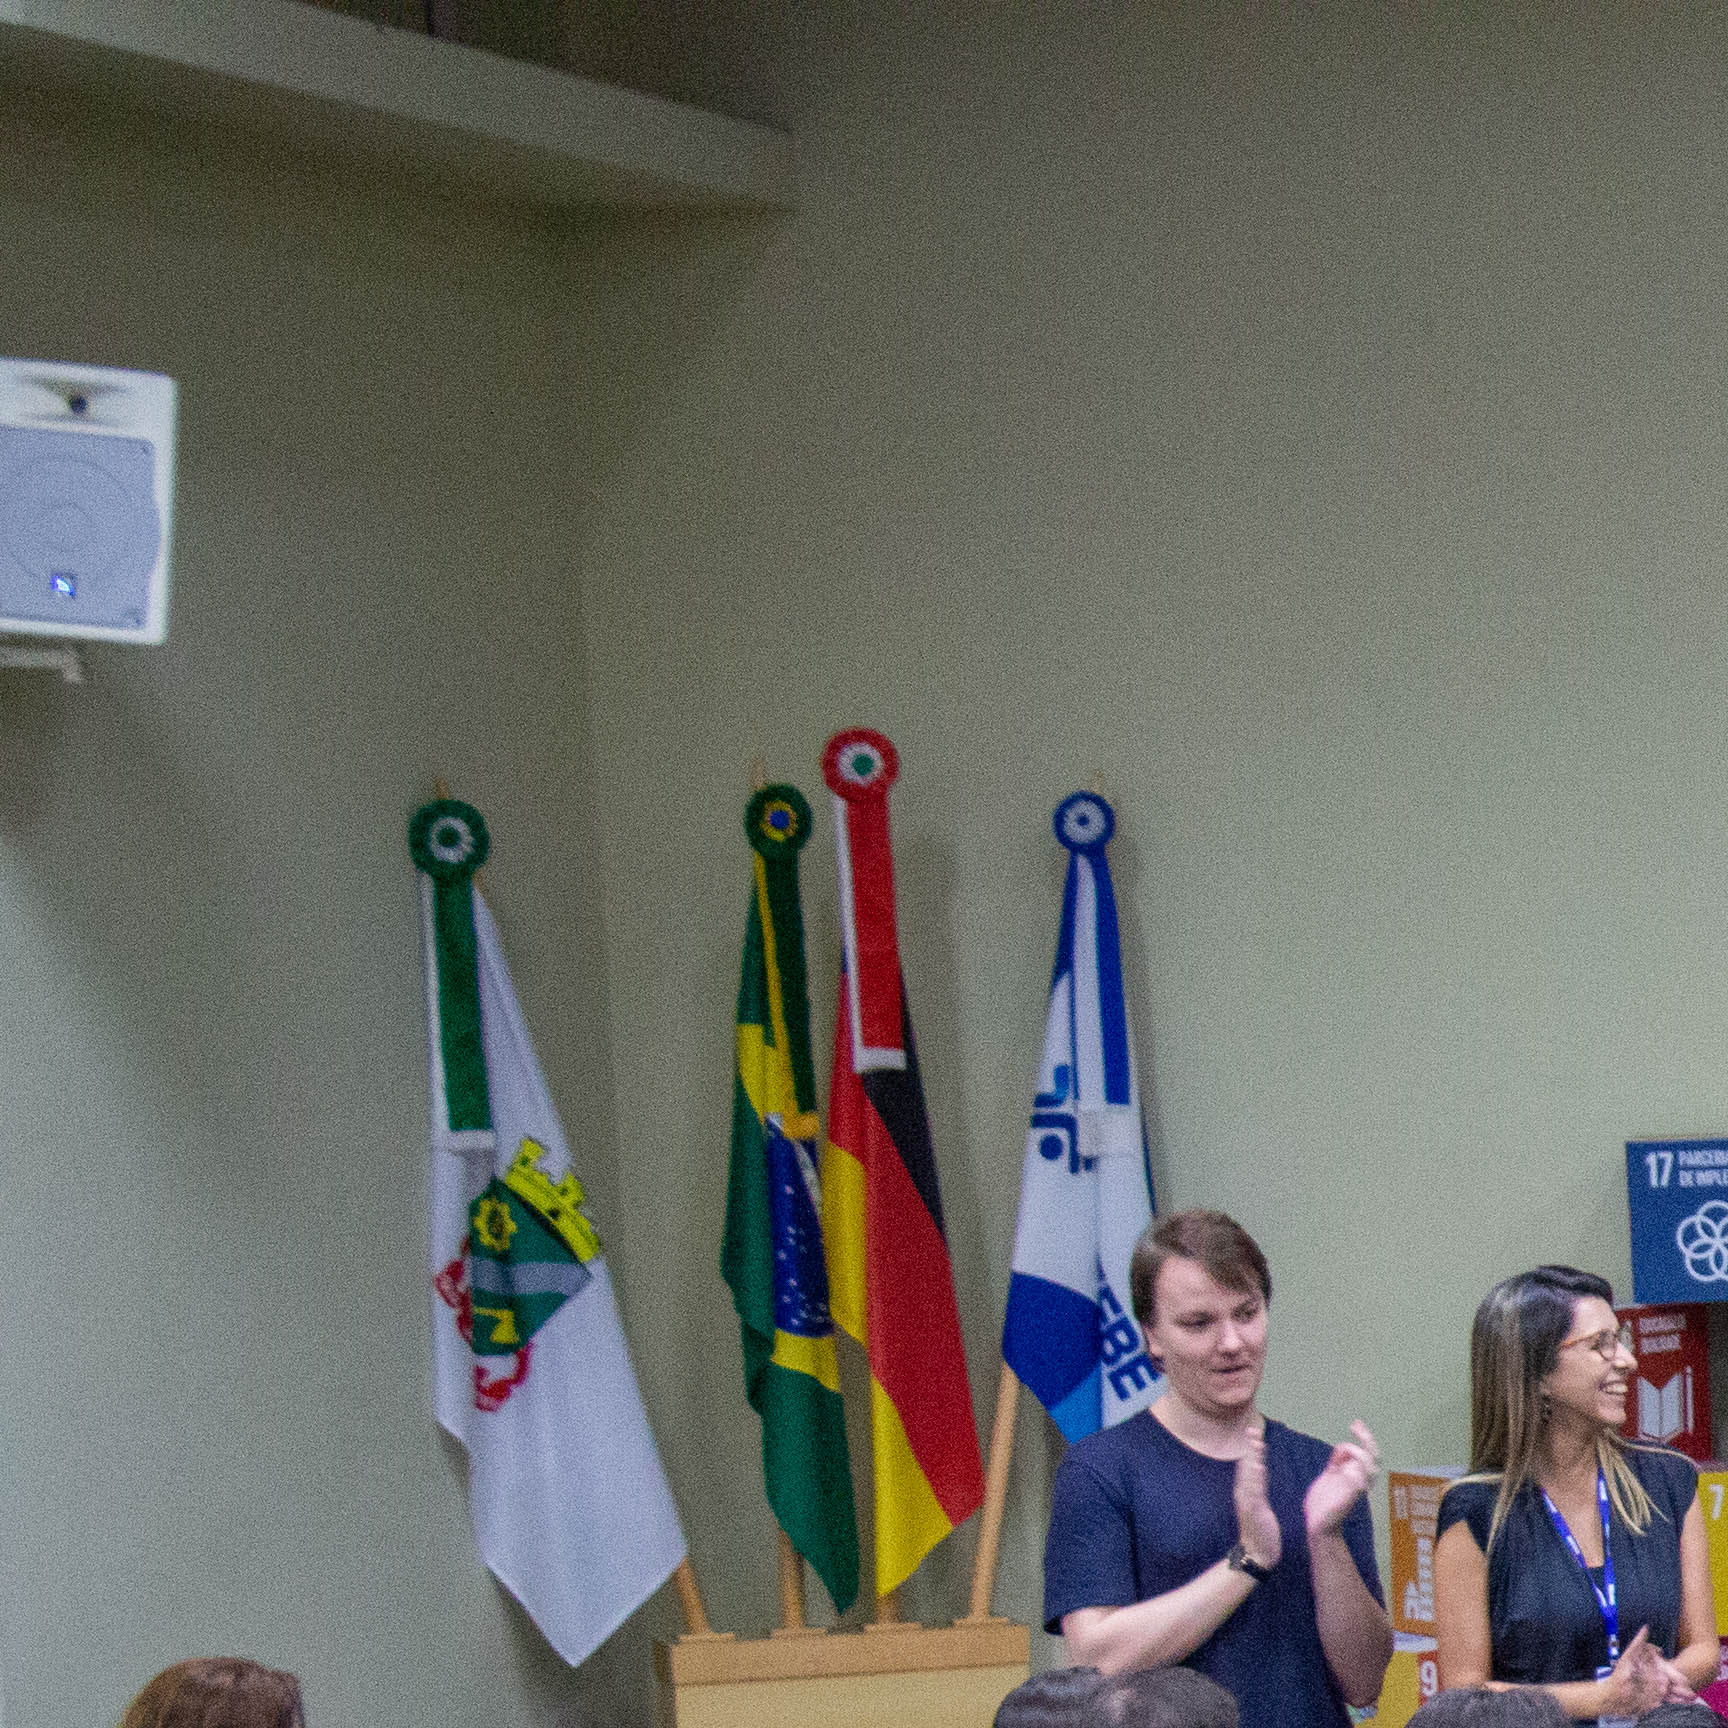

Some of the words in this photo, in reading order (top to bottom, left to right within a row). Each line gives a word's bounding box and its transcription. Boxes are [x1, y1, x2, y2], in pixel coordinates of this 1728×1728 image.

[1645, 1152, 1674, 1188] 17
[1708, 1484, 1723, 1520] 7
[1421, 1661, 1437, 1697] 9
